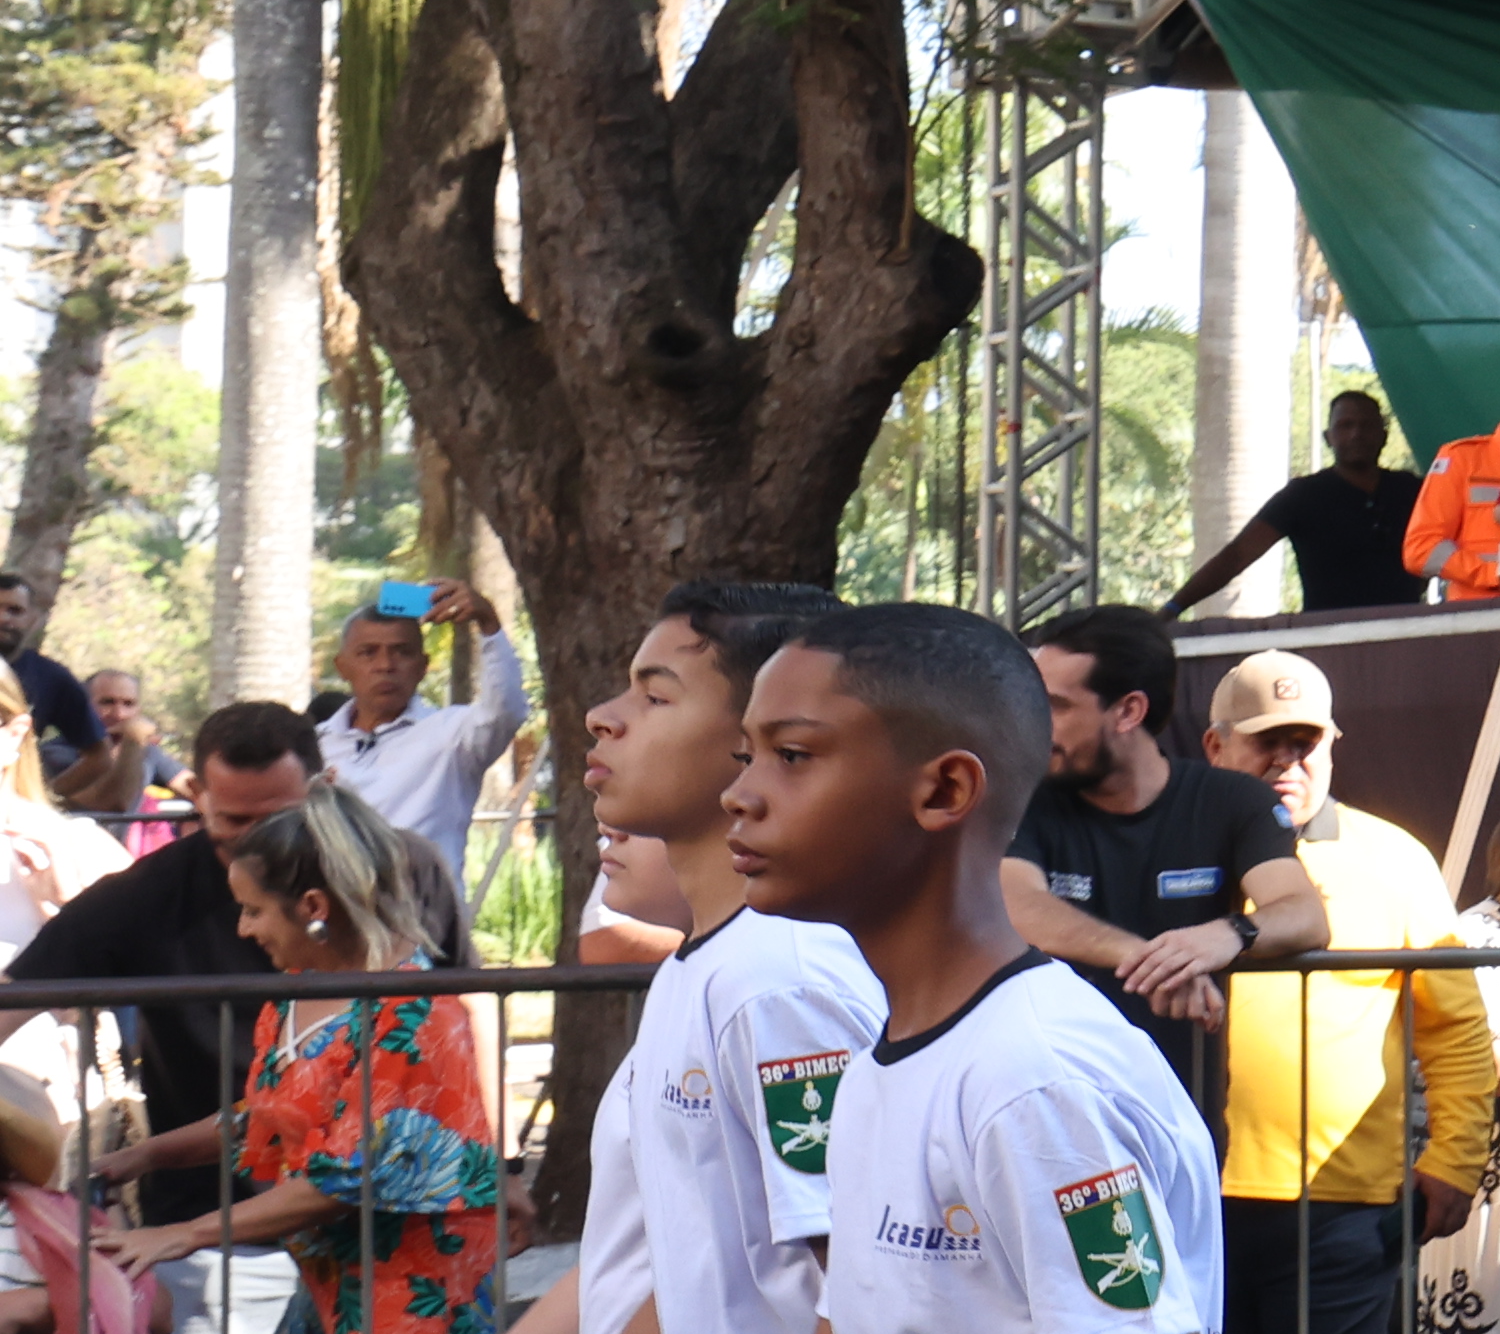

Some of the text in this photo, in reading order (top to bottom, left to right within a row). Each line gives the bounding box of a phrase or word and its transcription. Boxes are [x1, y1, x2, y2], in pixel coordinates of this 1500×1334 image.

[761, 1053, 850, 1085] 36º BIMEC
[1059, 1185, 1090, 1213] 36º
[875, 1204, 945, 1250] Icasu
